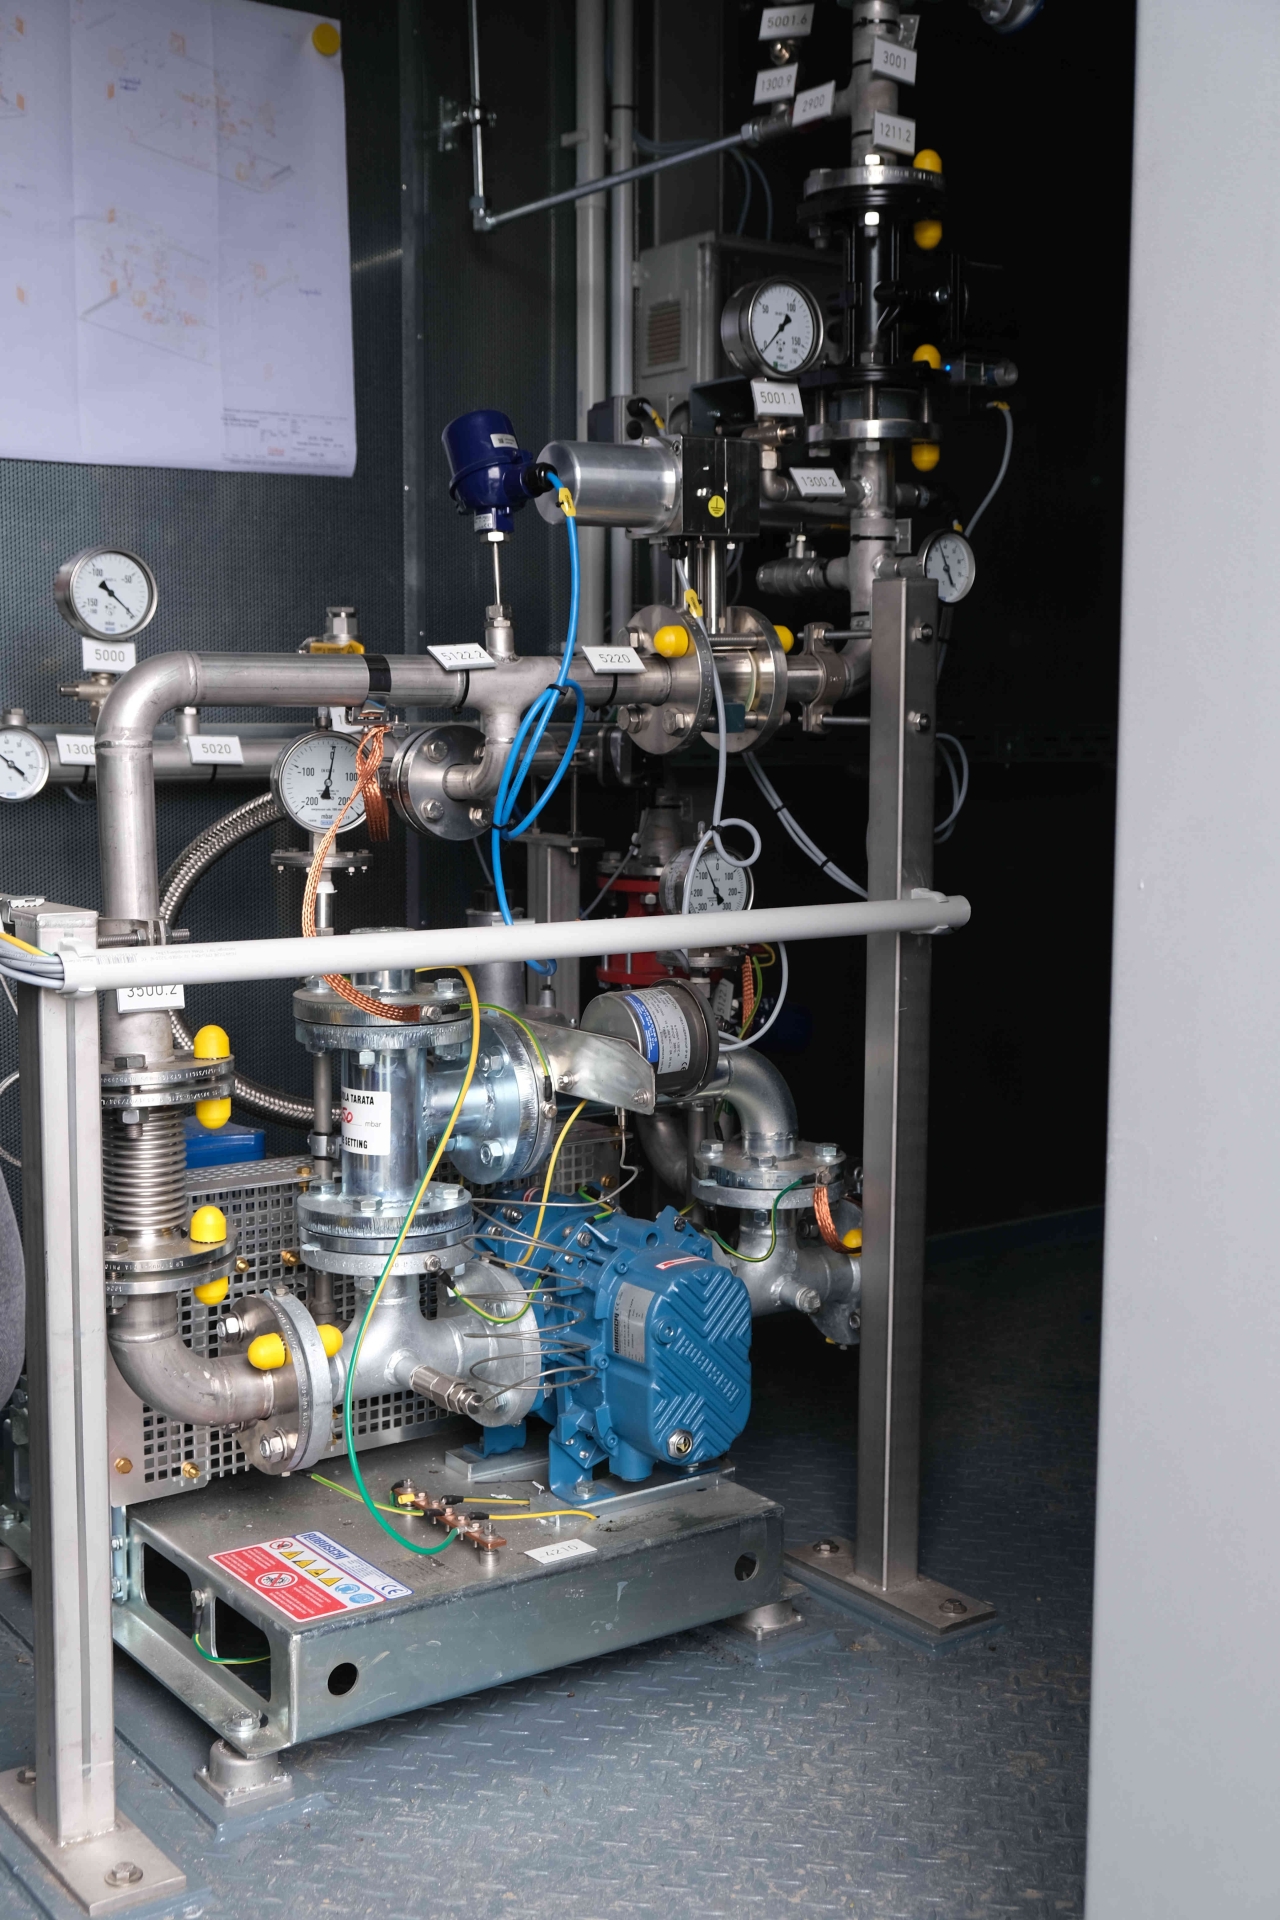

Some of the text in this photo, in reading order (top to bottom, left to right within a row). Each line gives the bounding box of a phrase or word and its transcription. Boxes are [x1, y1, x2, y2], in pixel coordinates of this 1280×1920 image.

[767, 13, 808, 29] 5001.6
[883, 50, 907, 70] 3001
[761, 74, 793, 92] 1300.9
[802, 94, 826, 113] 2900
[880, 122, 911, 143] 1211.2
[762, 304, 770, 314] 50
[760, 391, 796, 405] 5001.1
[801, 476, 837, 488] 1300.2
[94, 649, 126, 663] 5000
[440, 651, 486, 662] 5122.2
[598, 653, 631, 664] 5220
[201, 743, 232, 755] 5020
[297, 767, 315, 777] -100
[301, 796, 318, 806] -200
[716, 862, 720, 871] 0
[724, 872, 734, 881] 100
[728, 887, 738, 897] 200
[722, 903, 732, 911] 300
[350, 1094, 375, 1105] TARATA
[345, 1136, 368, 1149] SETTING
[301, 1531, 349, 1561] ROBUSCHI
